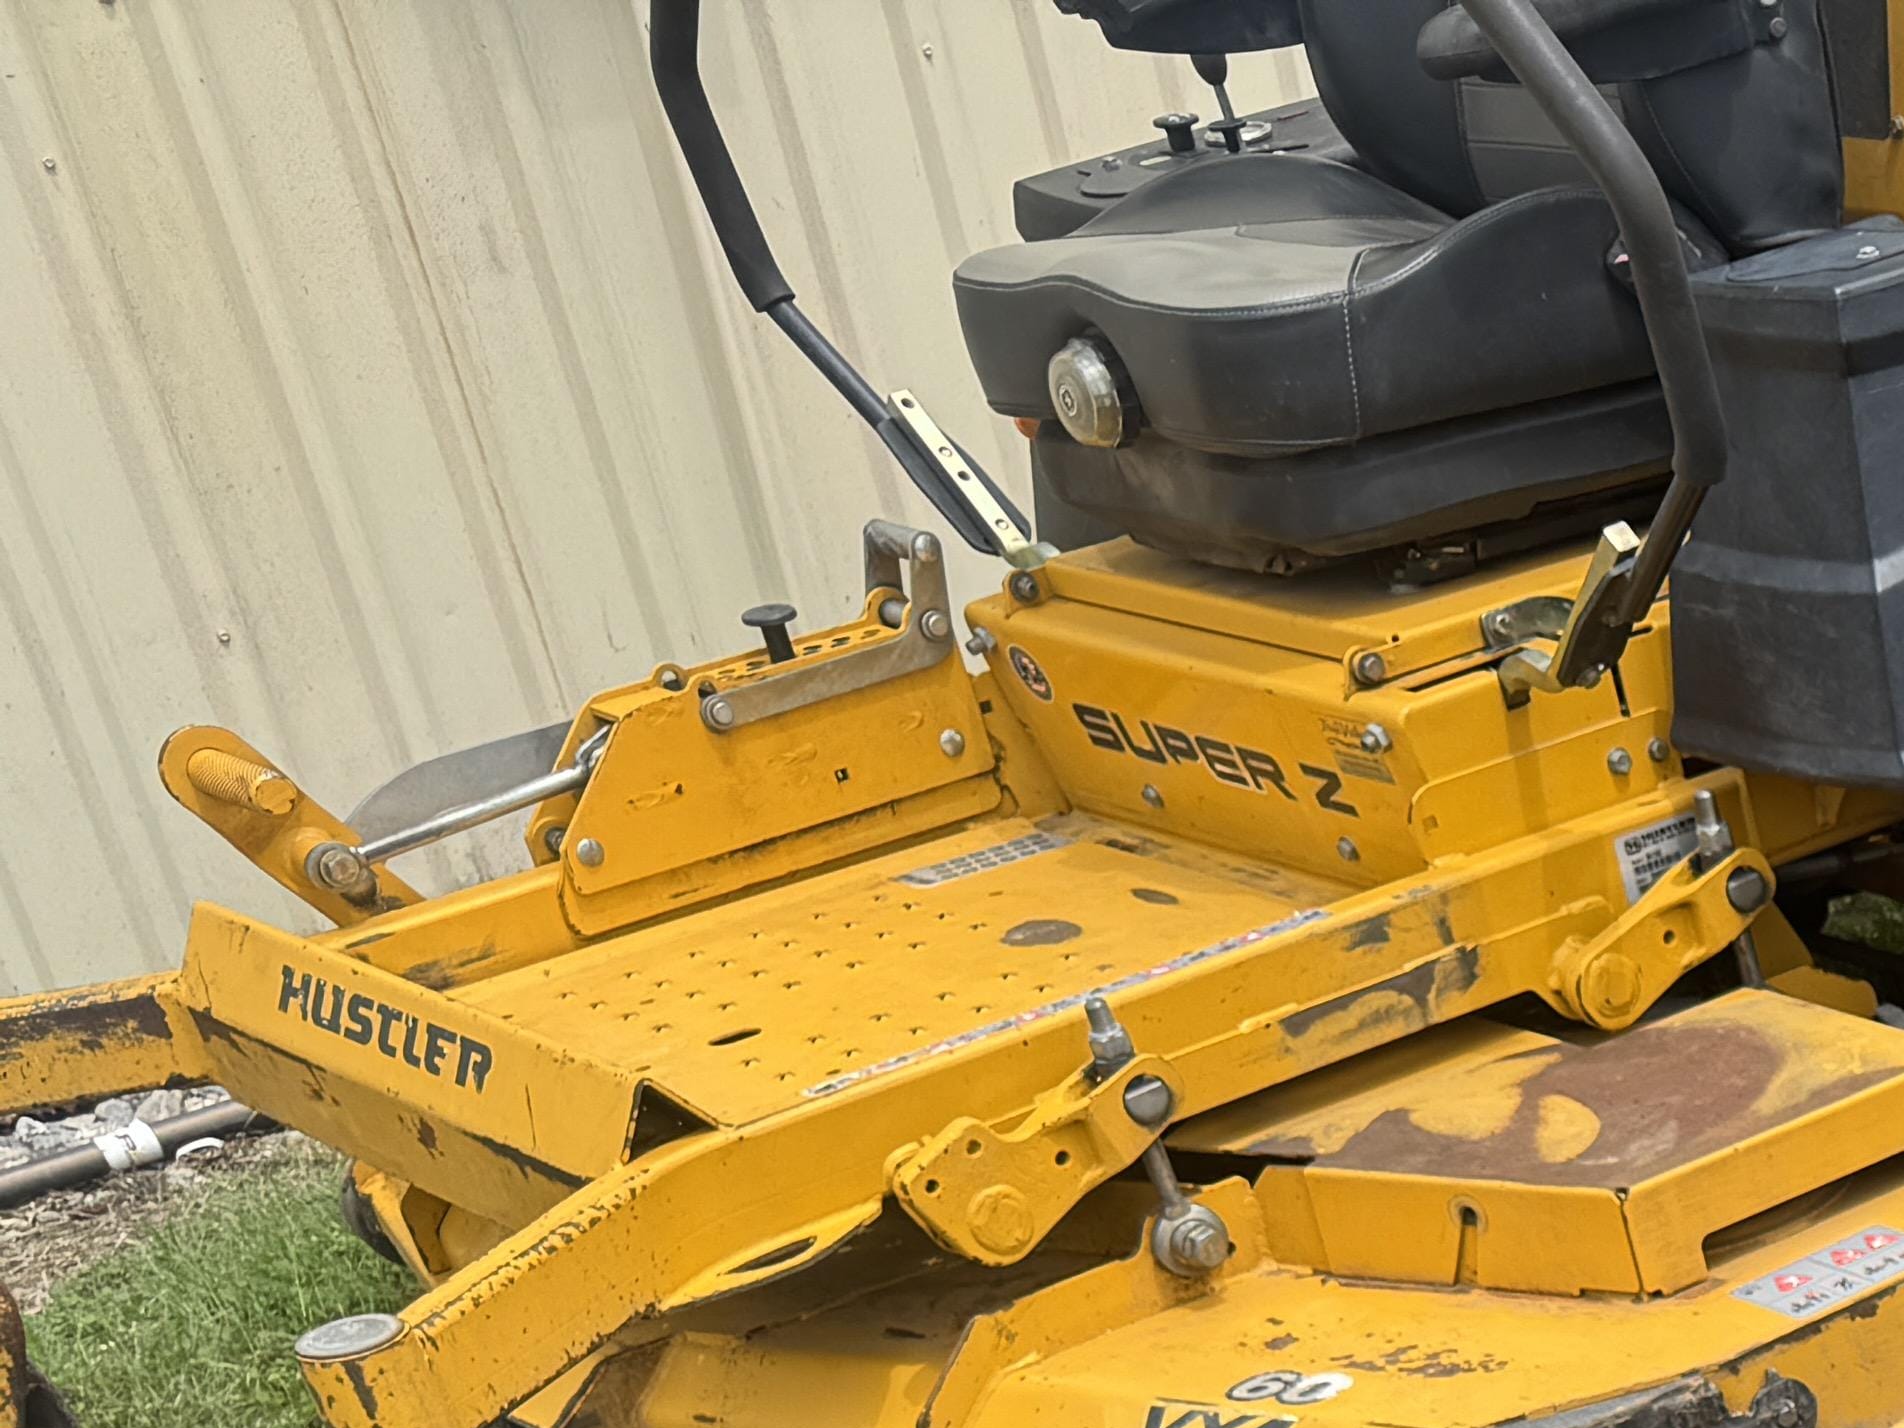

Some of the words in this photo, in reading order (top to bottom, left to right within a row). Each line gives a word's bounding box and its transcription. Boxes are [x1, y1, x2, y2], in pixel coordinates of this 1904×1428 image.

[1072, 702, 1299, 801] SUPER
[1298, 761, 1361, 818] Z
[277, 964, 494, 1095] HUSTLER
[1225, 1369, 1354, 1406] 60
